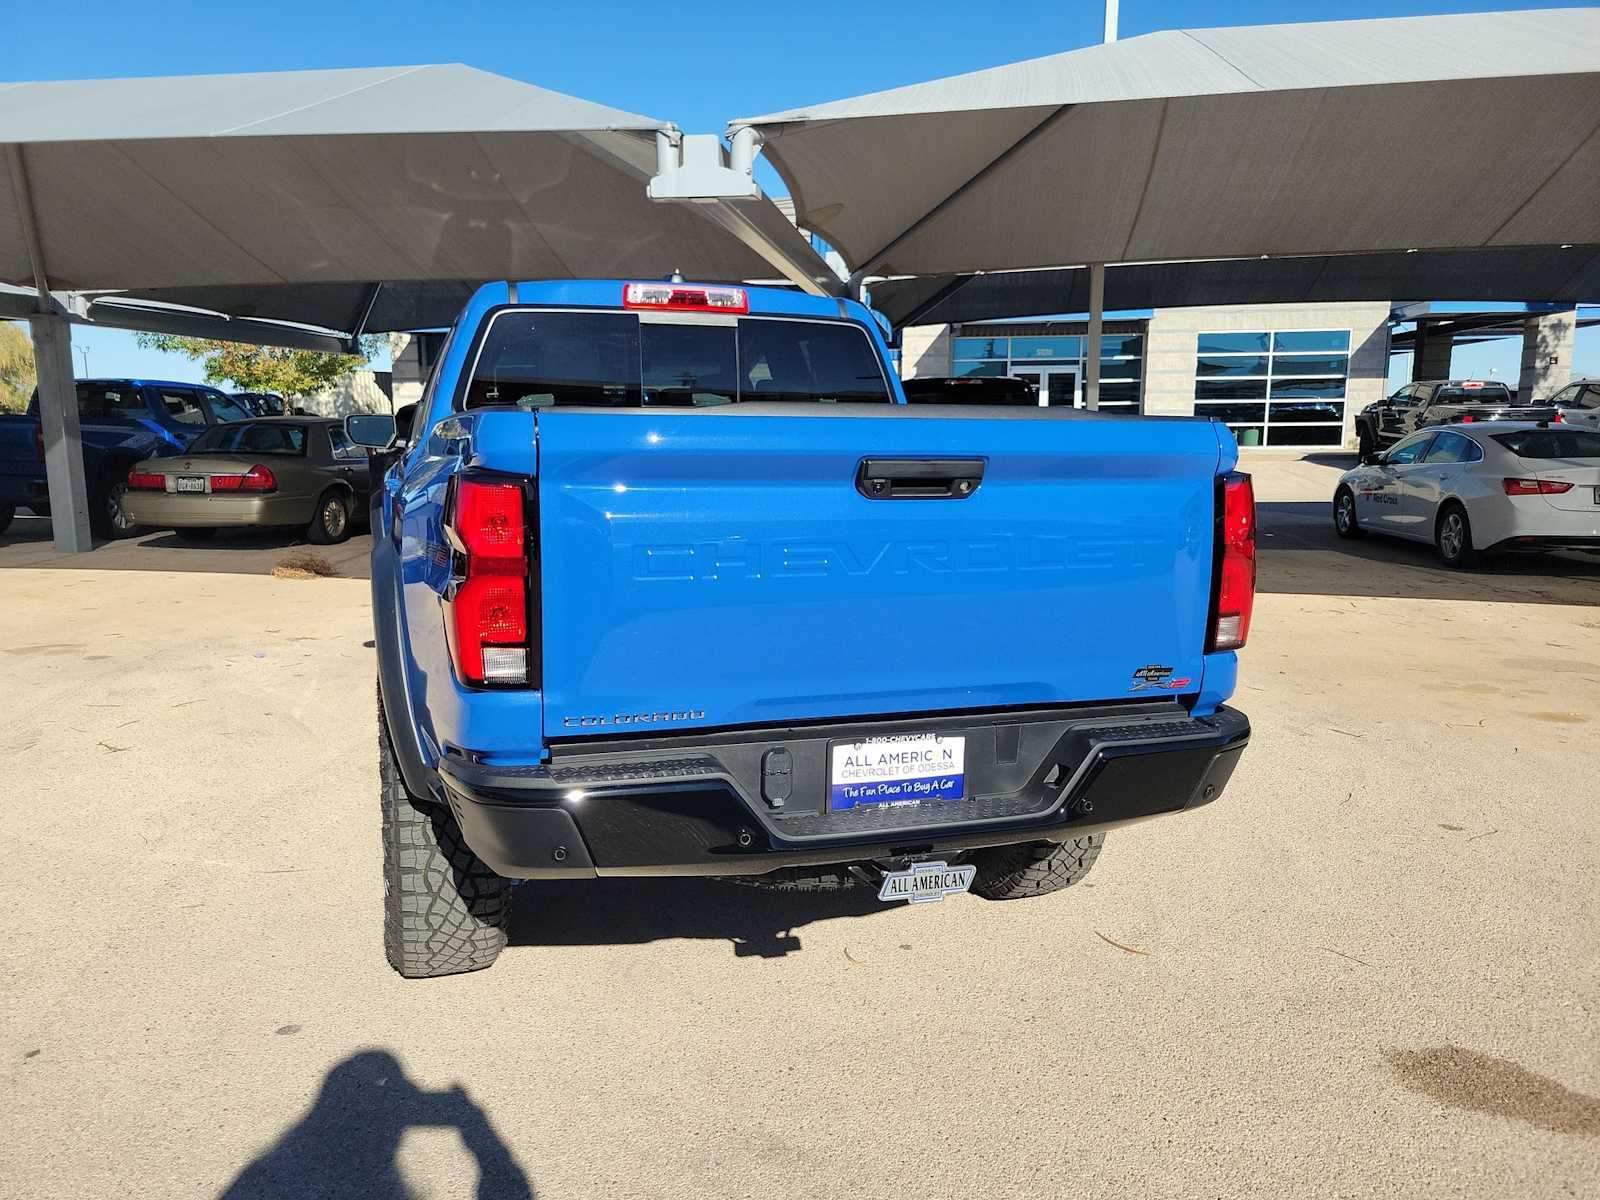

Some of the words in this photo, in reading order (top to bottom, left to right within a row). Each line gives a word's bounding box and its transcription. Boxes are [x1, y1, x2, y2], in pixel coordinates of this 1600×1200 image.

[632, 534, 1166, 582] CHEVROLET
[564, 709, 706, 728] COLORADO
[841, 766, 900, 779] CHEVROLET
[902, 764, 915, 775] OF
[917, 760, 956, 774] ODESSA
[844, 755, 873, 768] ALL
[842, 786, 859, 798] The
[860, 785, 877, 796] Fun
[878, 783, 901, 795] Place
[902, 782, 912, 793] To
[913, 781, 931, 794] Buy
[931, 780, 939, 789] A
[940, 779, 955, 789] Car
[890, 799, 921, 808] AMERICAN
[890, 878, 909, 894] ALL
[911, 872, 966, 892] AMERICAN
